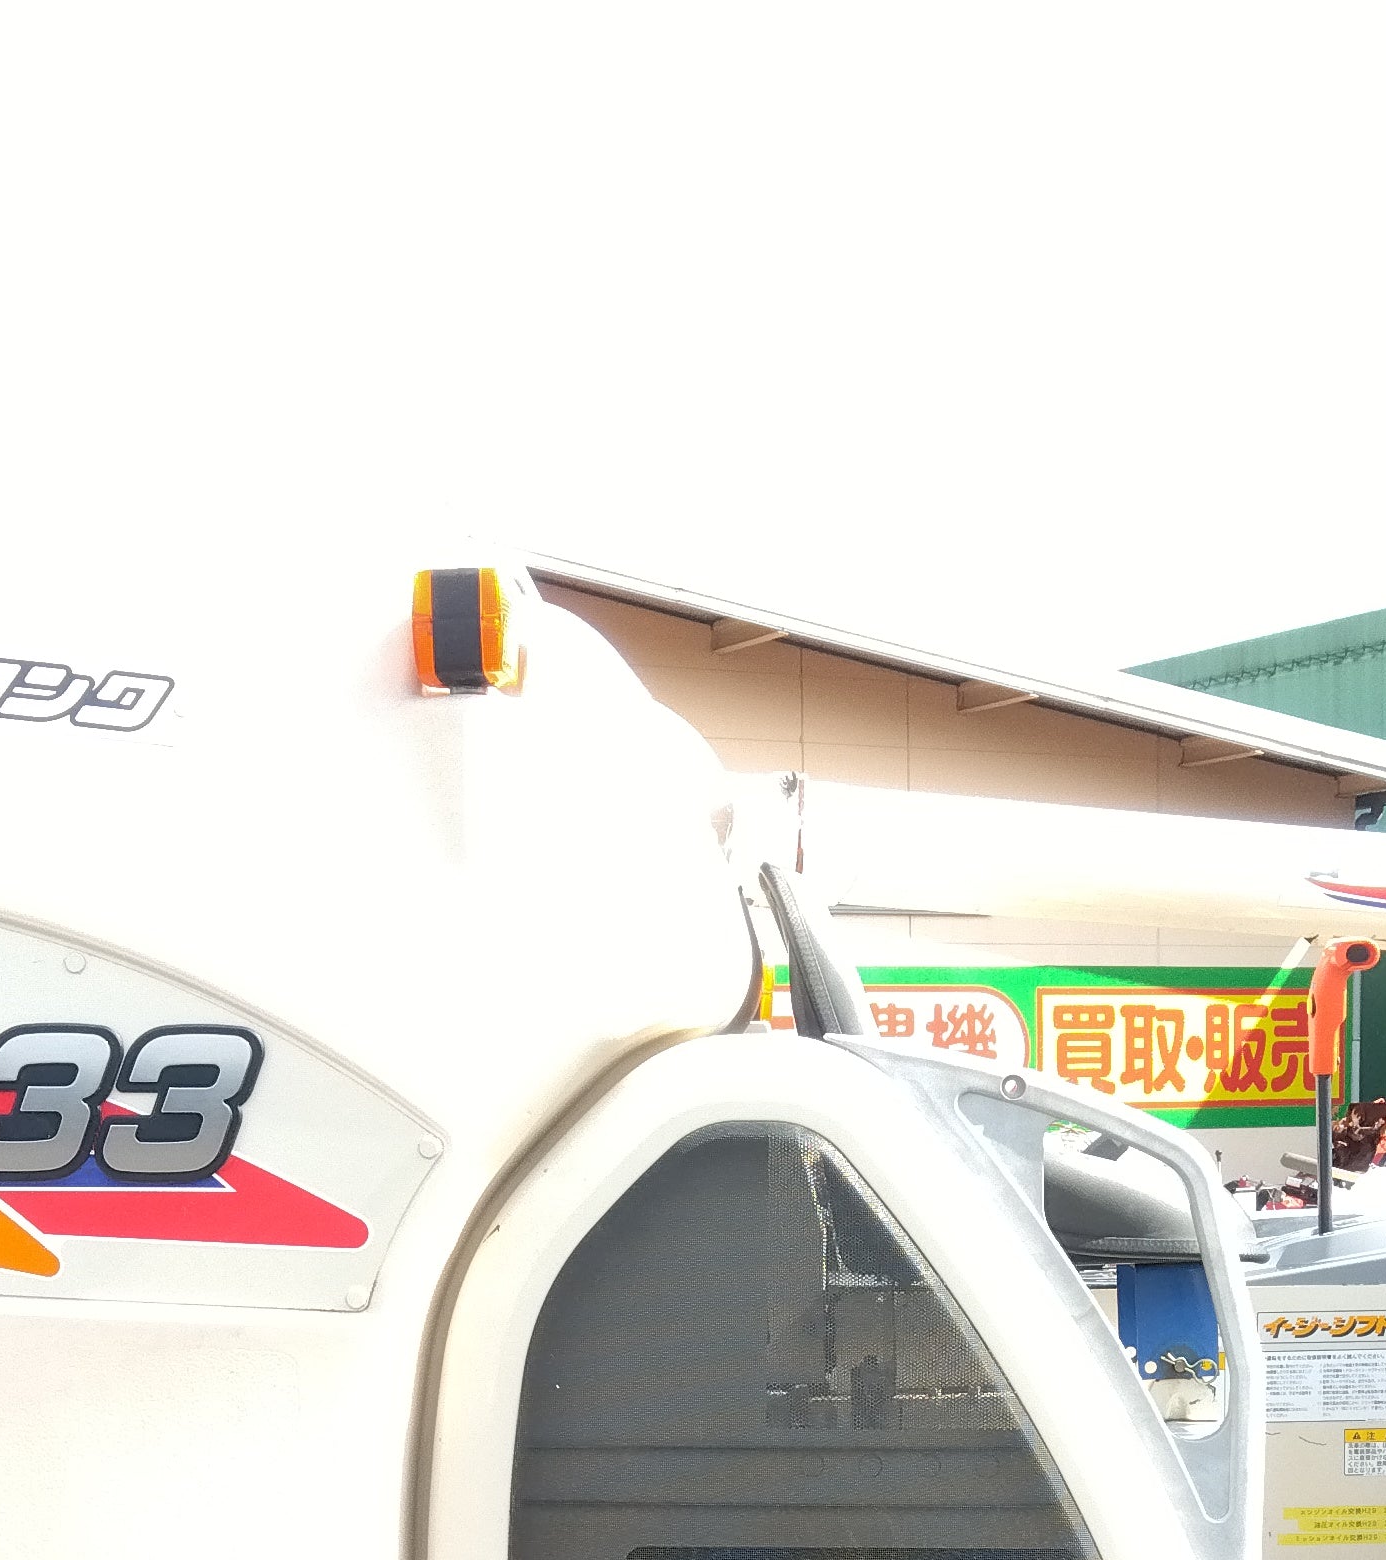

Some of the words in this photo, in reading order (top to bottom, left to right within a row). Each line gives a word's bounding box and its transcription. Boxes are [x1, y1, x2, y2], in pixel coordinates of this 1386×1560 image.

[1053, 1003, 1316, 1095] 買取・販売
